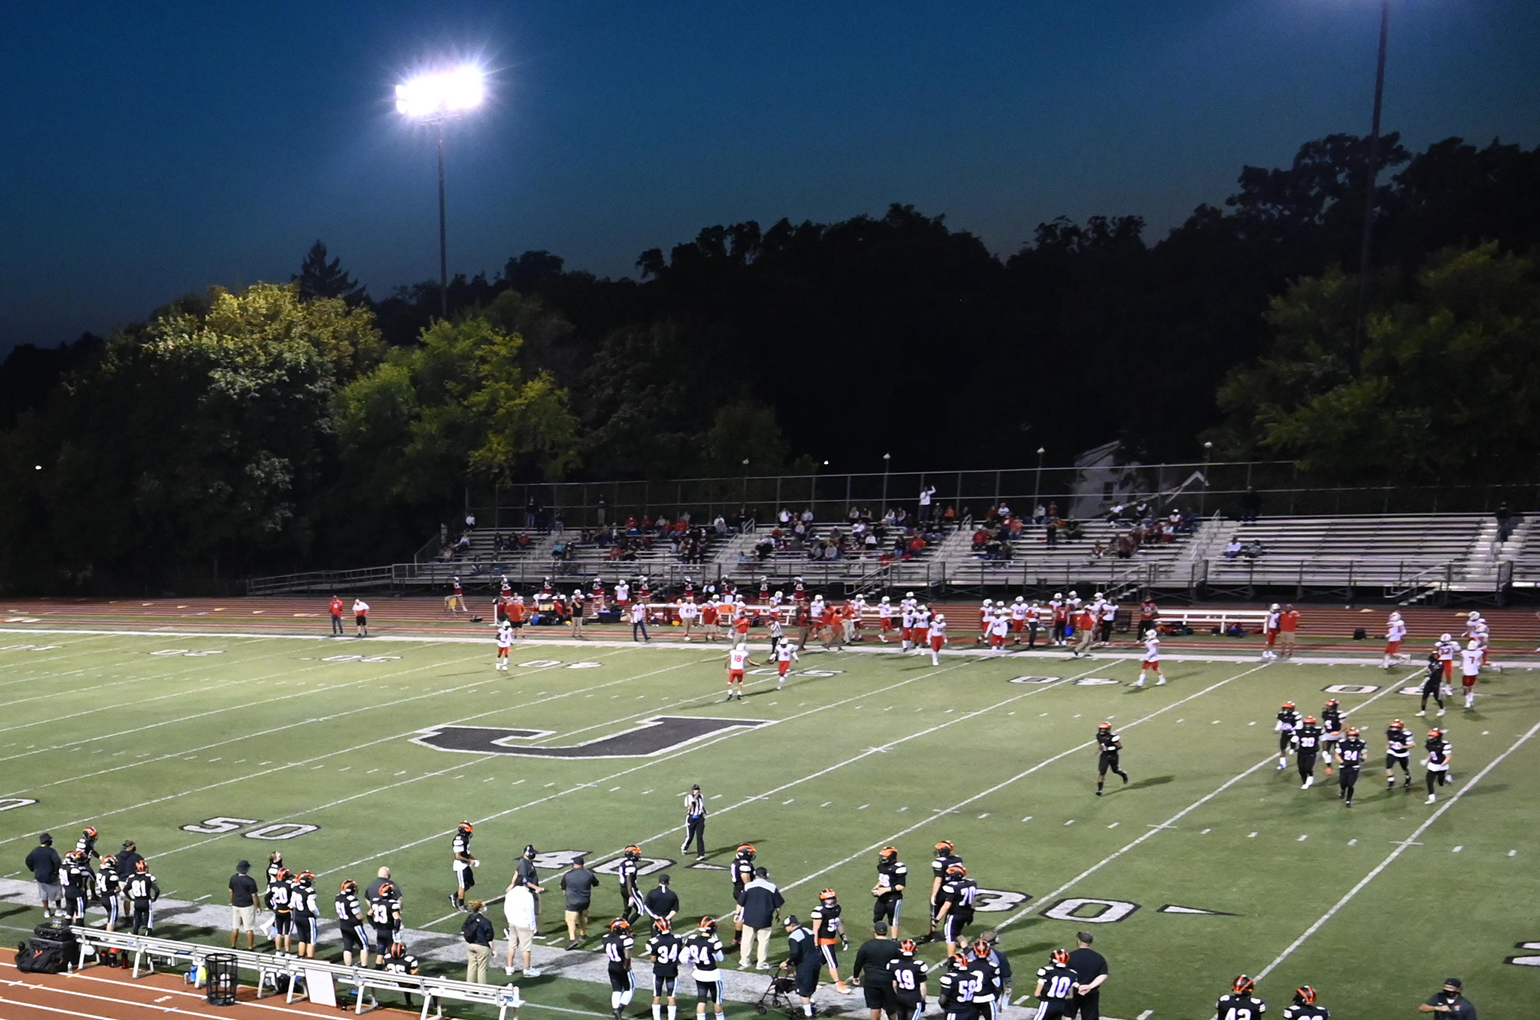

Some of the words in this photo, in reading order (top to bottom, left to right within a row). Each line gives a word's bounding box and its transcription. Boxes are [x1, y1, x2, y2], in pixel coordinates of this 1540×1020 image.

[734, 654, 743, 663] 18
[1343, 750, 1358, 762] 24
[178, 816, 321, 841] 50
[131, 880, 146, 897] 81
[271, 886, 288, 904] 20
[657, 944, 678, 965] 34
[894, 969, 915, 990] 19
[1046, 976, 1071, 998] 10
